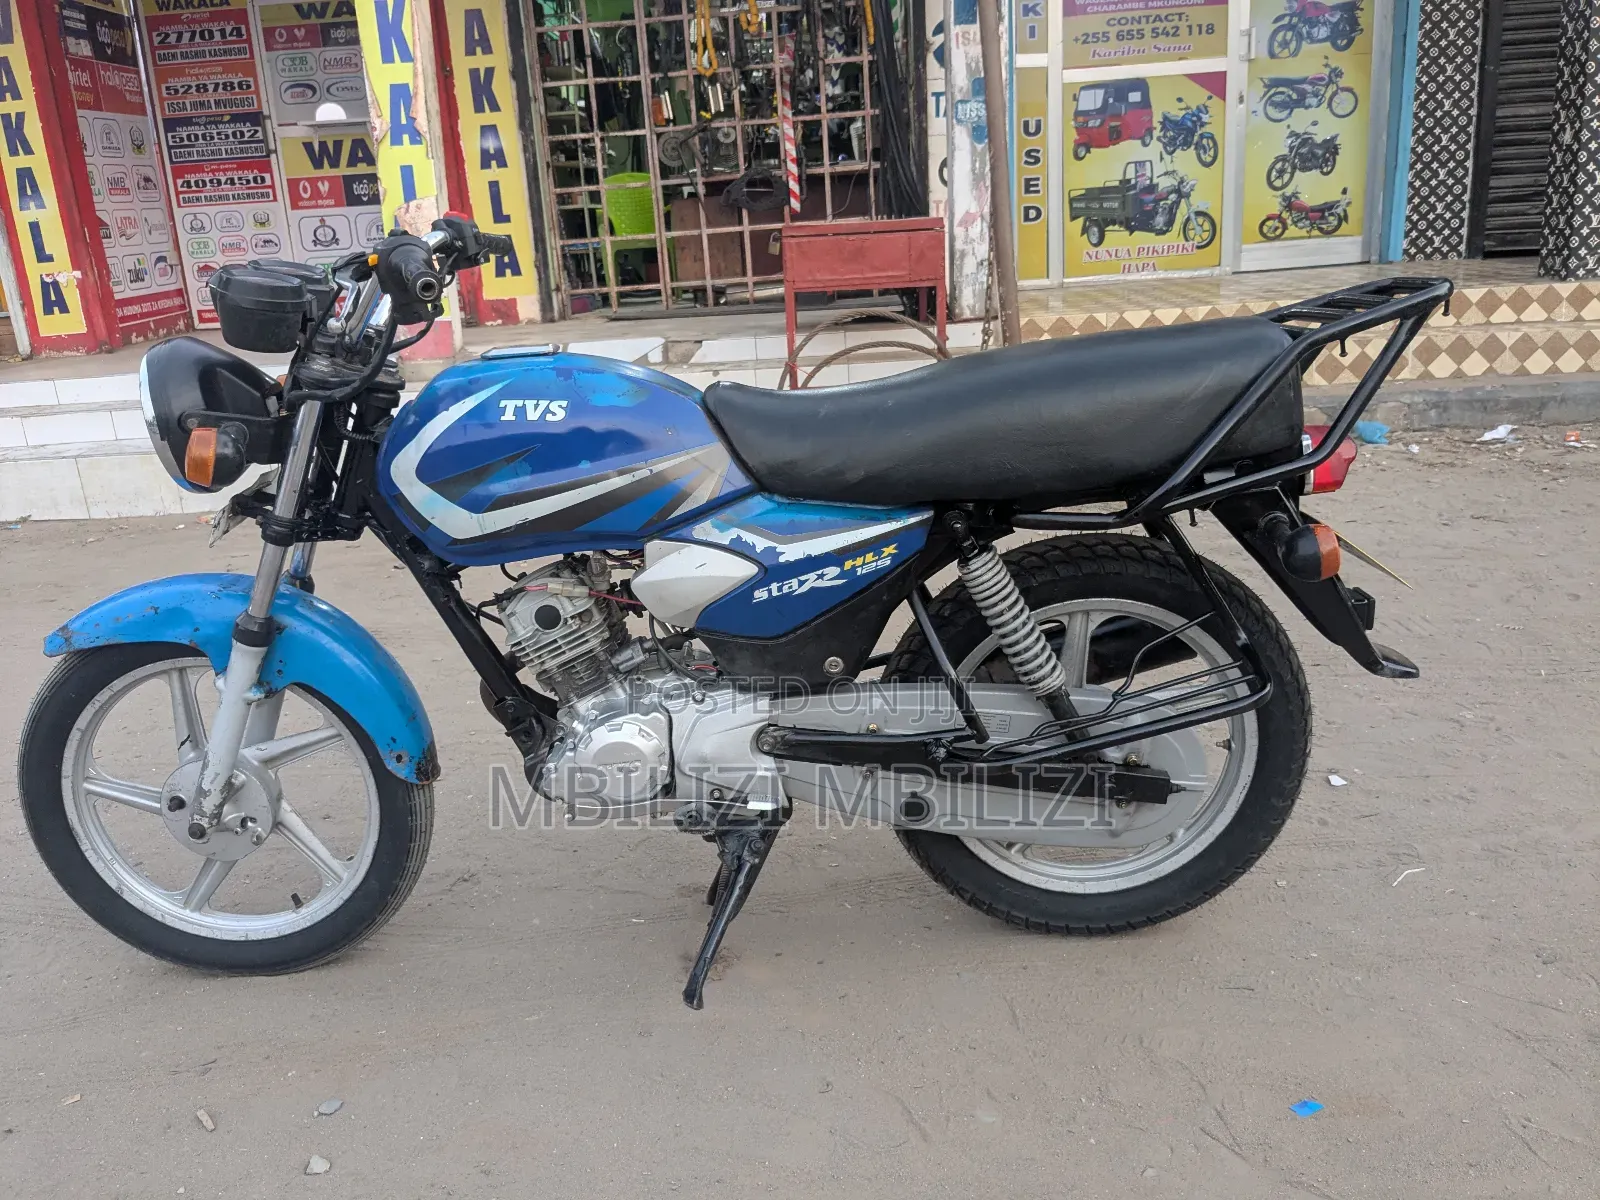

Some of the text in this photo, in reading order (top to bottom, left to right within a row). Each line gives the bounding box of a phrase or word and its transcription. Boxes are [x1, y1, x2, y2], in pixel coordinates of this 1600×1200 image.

[1087, 3, 1146, 13] CHARAMBE
[202, 21, 235, 29] WAKALA
[156, 27, 245, 45] 277014
[1073, 23, 1215, 45] +255 655 542 118
[1091, 43, 1192, 59] Karibu Sana
[165, 80, 252, 96] 528786
[167, 96, 255, 113] ISSA JUMA MVUGUSI
[170, 129, 260, 144] 506502
[196, 147, 223, 158] RASHID
[1021, 118, 1044, 224] USED
[107, 177, 126, 188] NMB
[180, 175, 266, 189] 409450
[115, 216, 139, 230] LATRA
[222, 241, 241, 249] NMB
[1083, 242, 1197, 262] NUNUA PIKIPIKI
[1121, 262, 1157, 274] HAPA
[499, 399, 568, 423] TVS
[843, 543, 899, 571] HLX
[856, 557, 892, 576] 125
